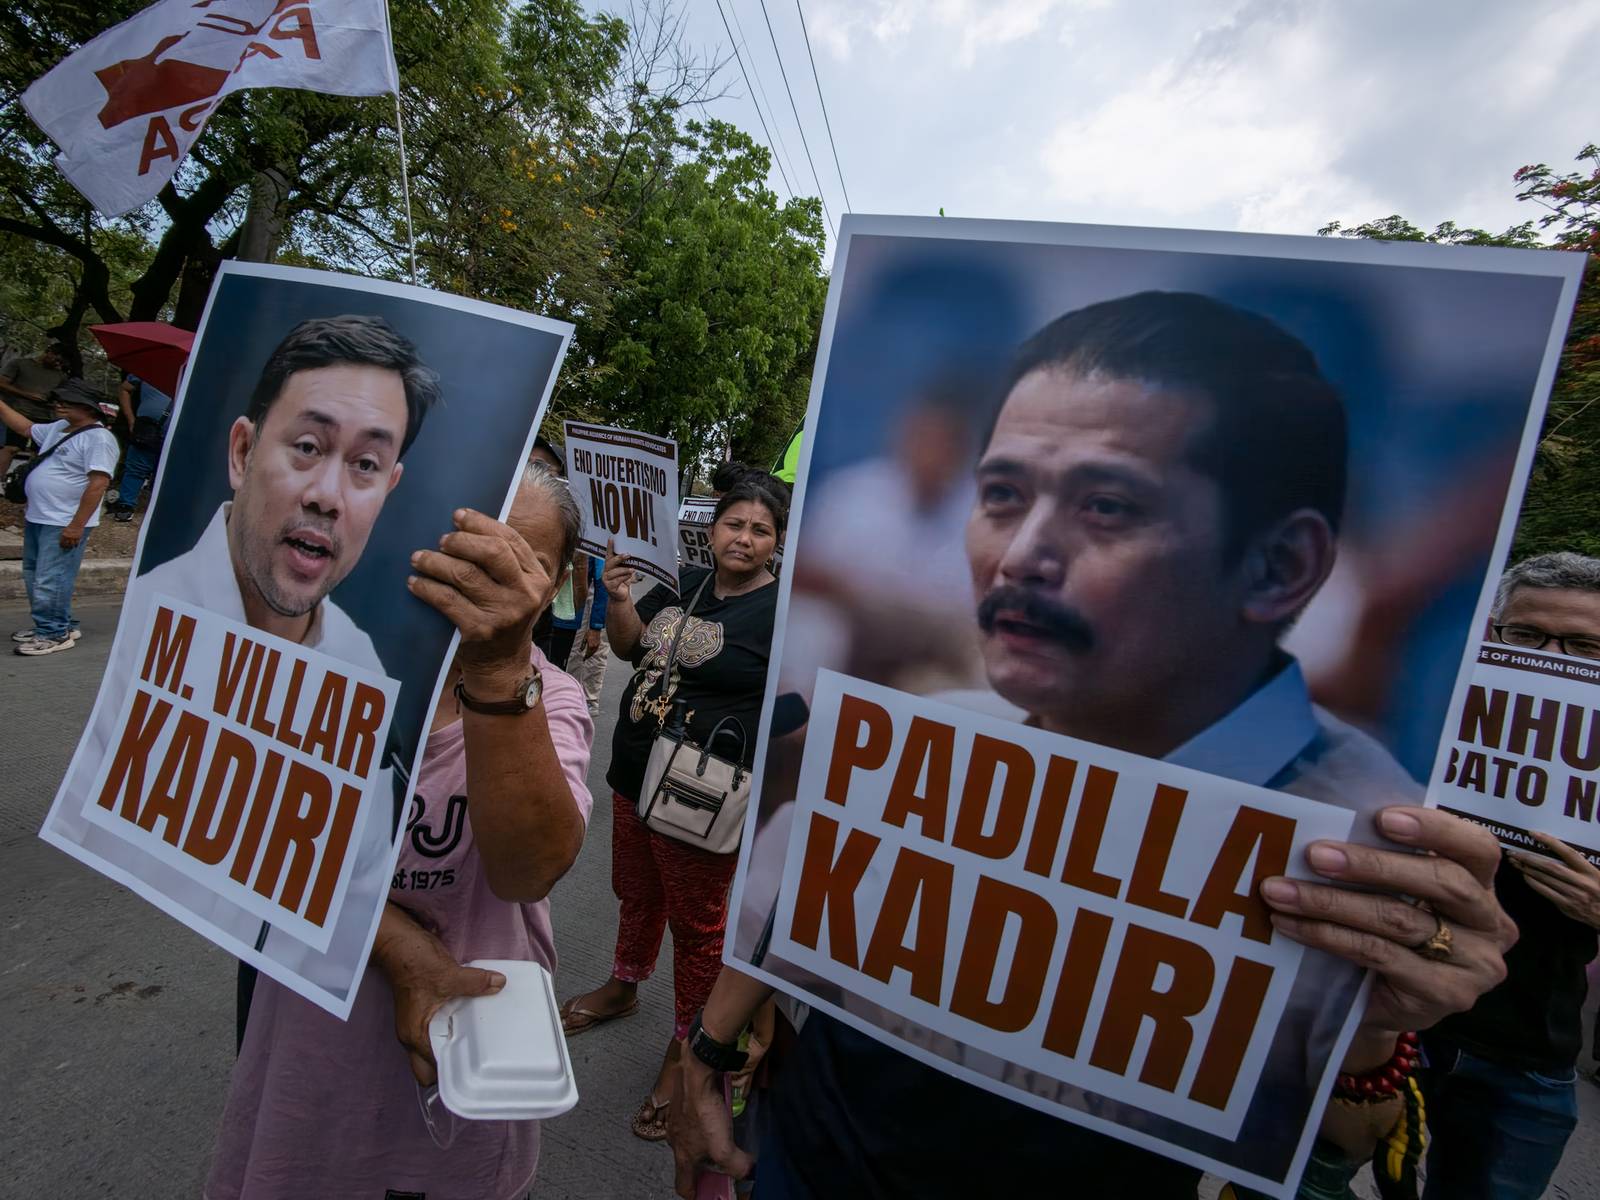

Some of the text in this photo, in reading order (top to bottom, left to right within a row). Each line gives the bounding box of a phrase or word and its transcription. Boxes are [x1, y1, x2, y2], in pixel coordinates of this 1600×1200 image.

[573, 448, 667, 497] END DUTERTISMO
[589, 478, 658, 547] NOW!
[140, 606, 385, 780] M. VILLAR
[1491, 653, 1510, 661] OF
[1511, 656, 1564, 672] HUMAN
[97, 689, 362, 928] KADIRI
[824, 693, 1298, 945] PADILLA
[411, 869, 455, 890] 1975
[790, 811, 1275, 1111] KADIRI
